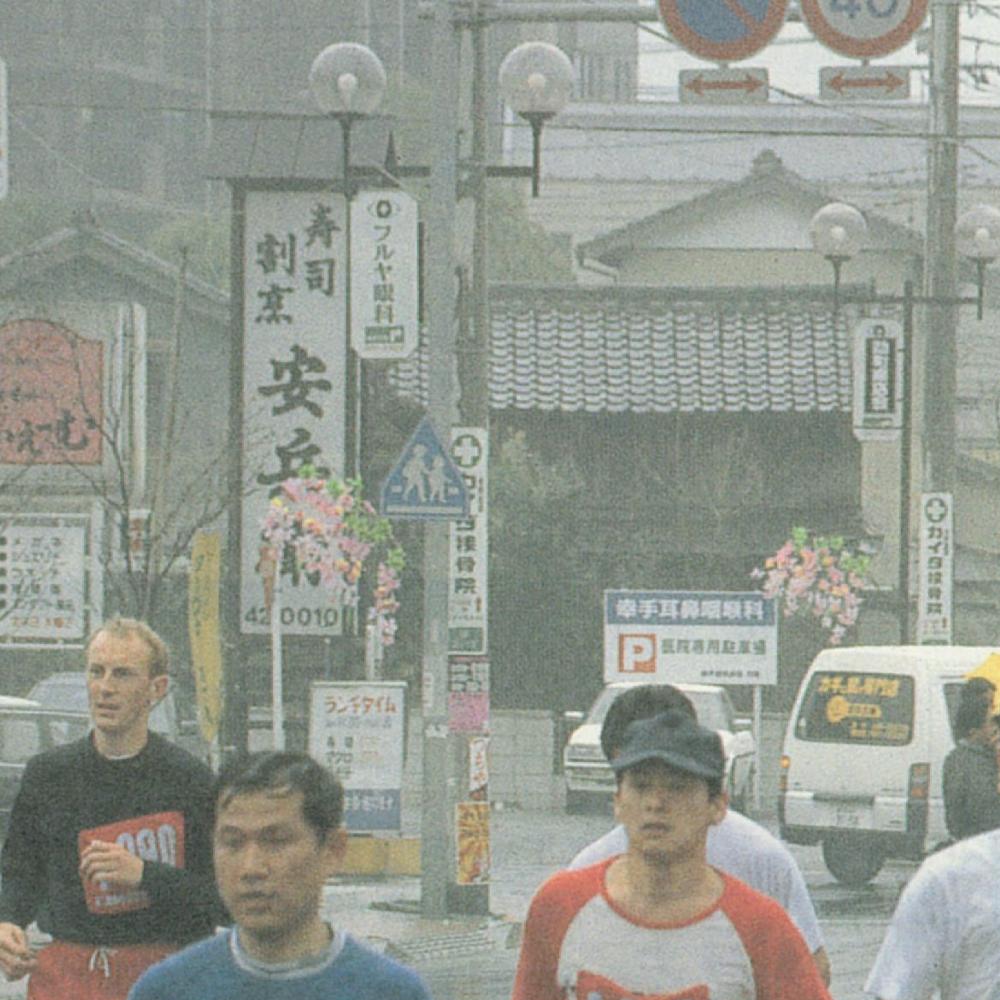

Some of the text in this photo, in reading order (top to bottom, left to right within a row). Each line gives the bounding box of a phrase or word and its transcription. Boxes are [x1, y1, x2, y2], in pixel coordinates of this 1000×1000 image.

[304, 203, 342, 297] 寿司
[623, 635, 655, 672] P
[324, 695, 397, 715] ランチタイム
